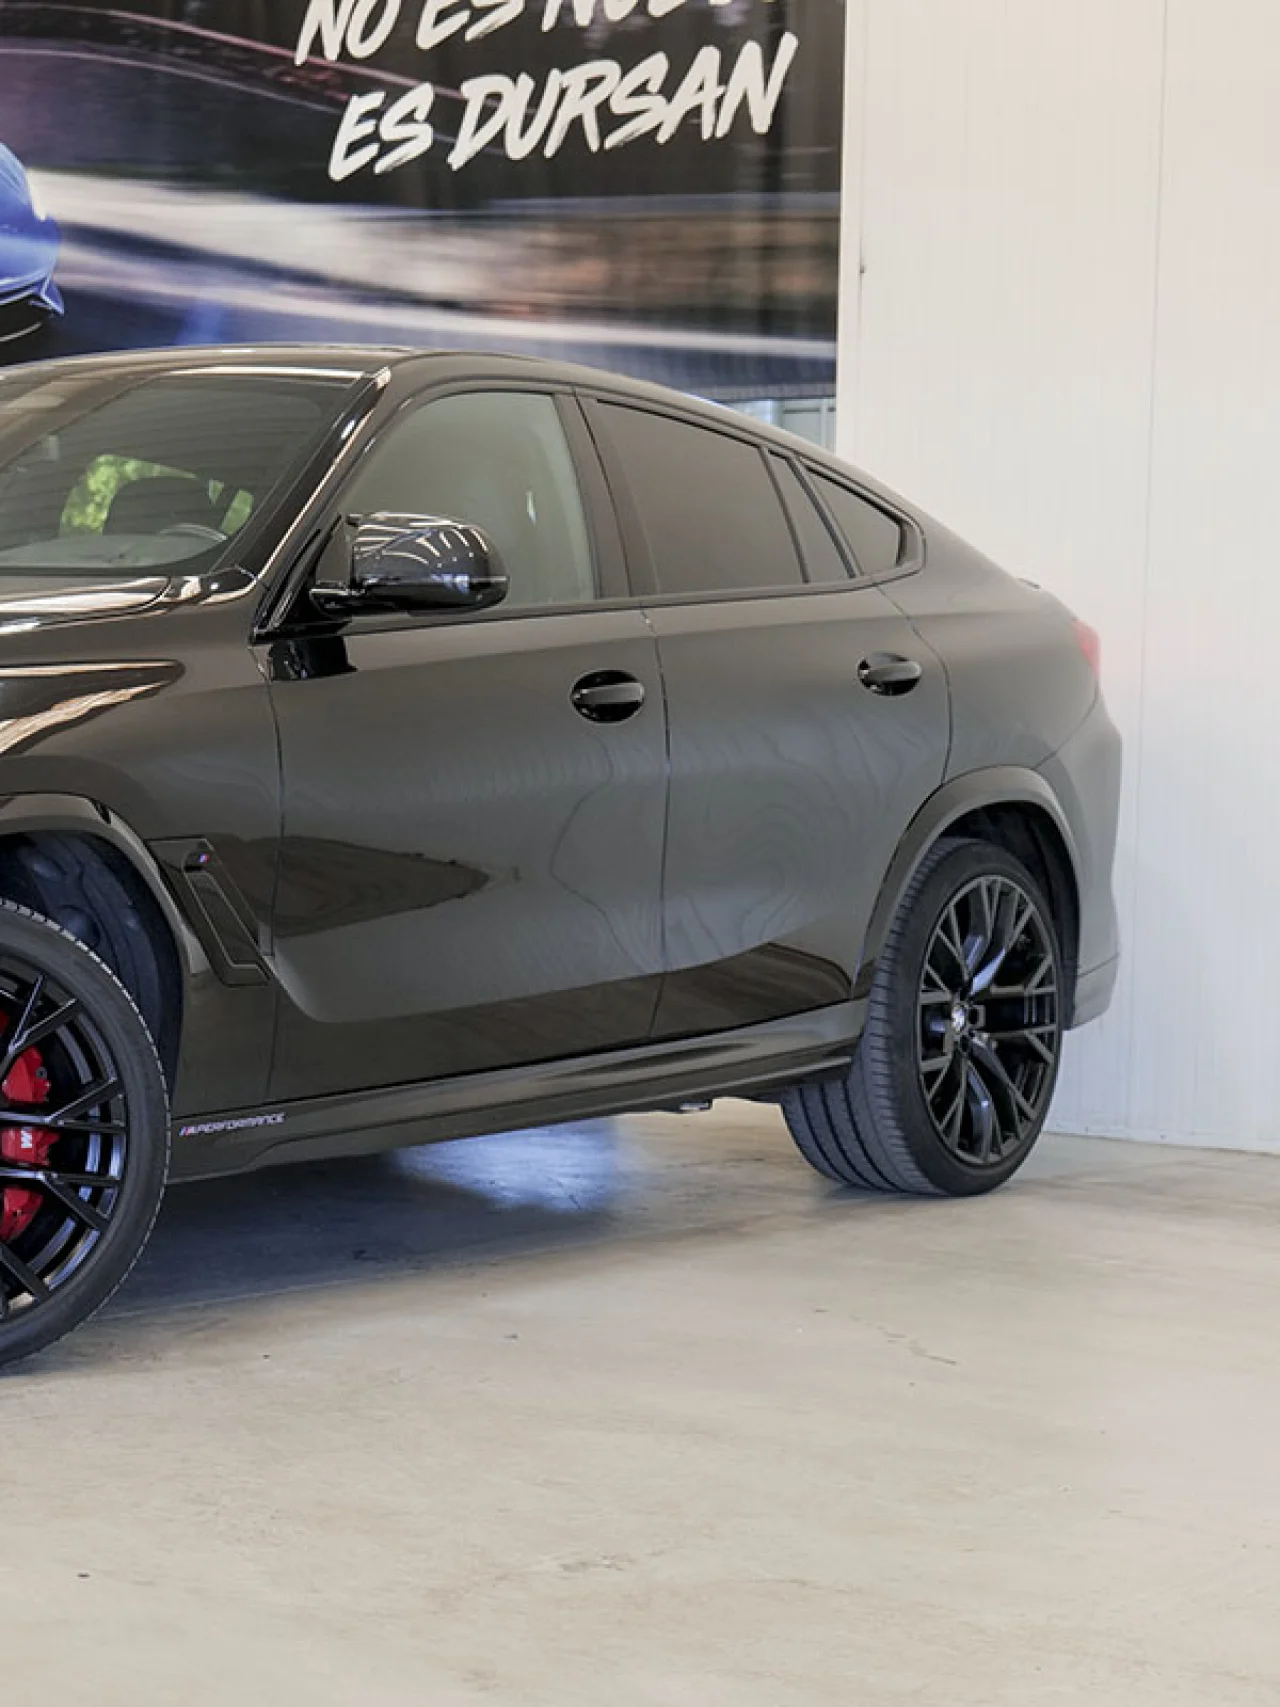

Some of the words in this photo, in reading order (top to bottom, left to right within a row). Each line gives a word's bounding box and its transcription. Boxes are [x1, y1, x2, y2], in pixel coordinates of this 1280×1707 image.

[294, 0, 401, 66] NO
[328, 82, 434, 183] ES
[446, 31, 799, 172] DURSAN
